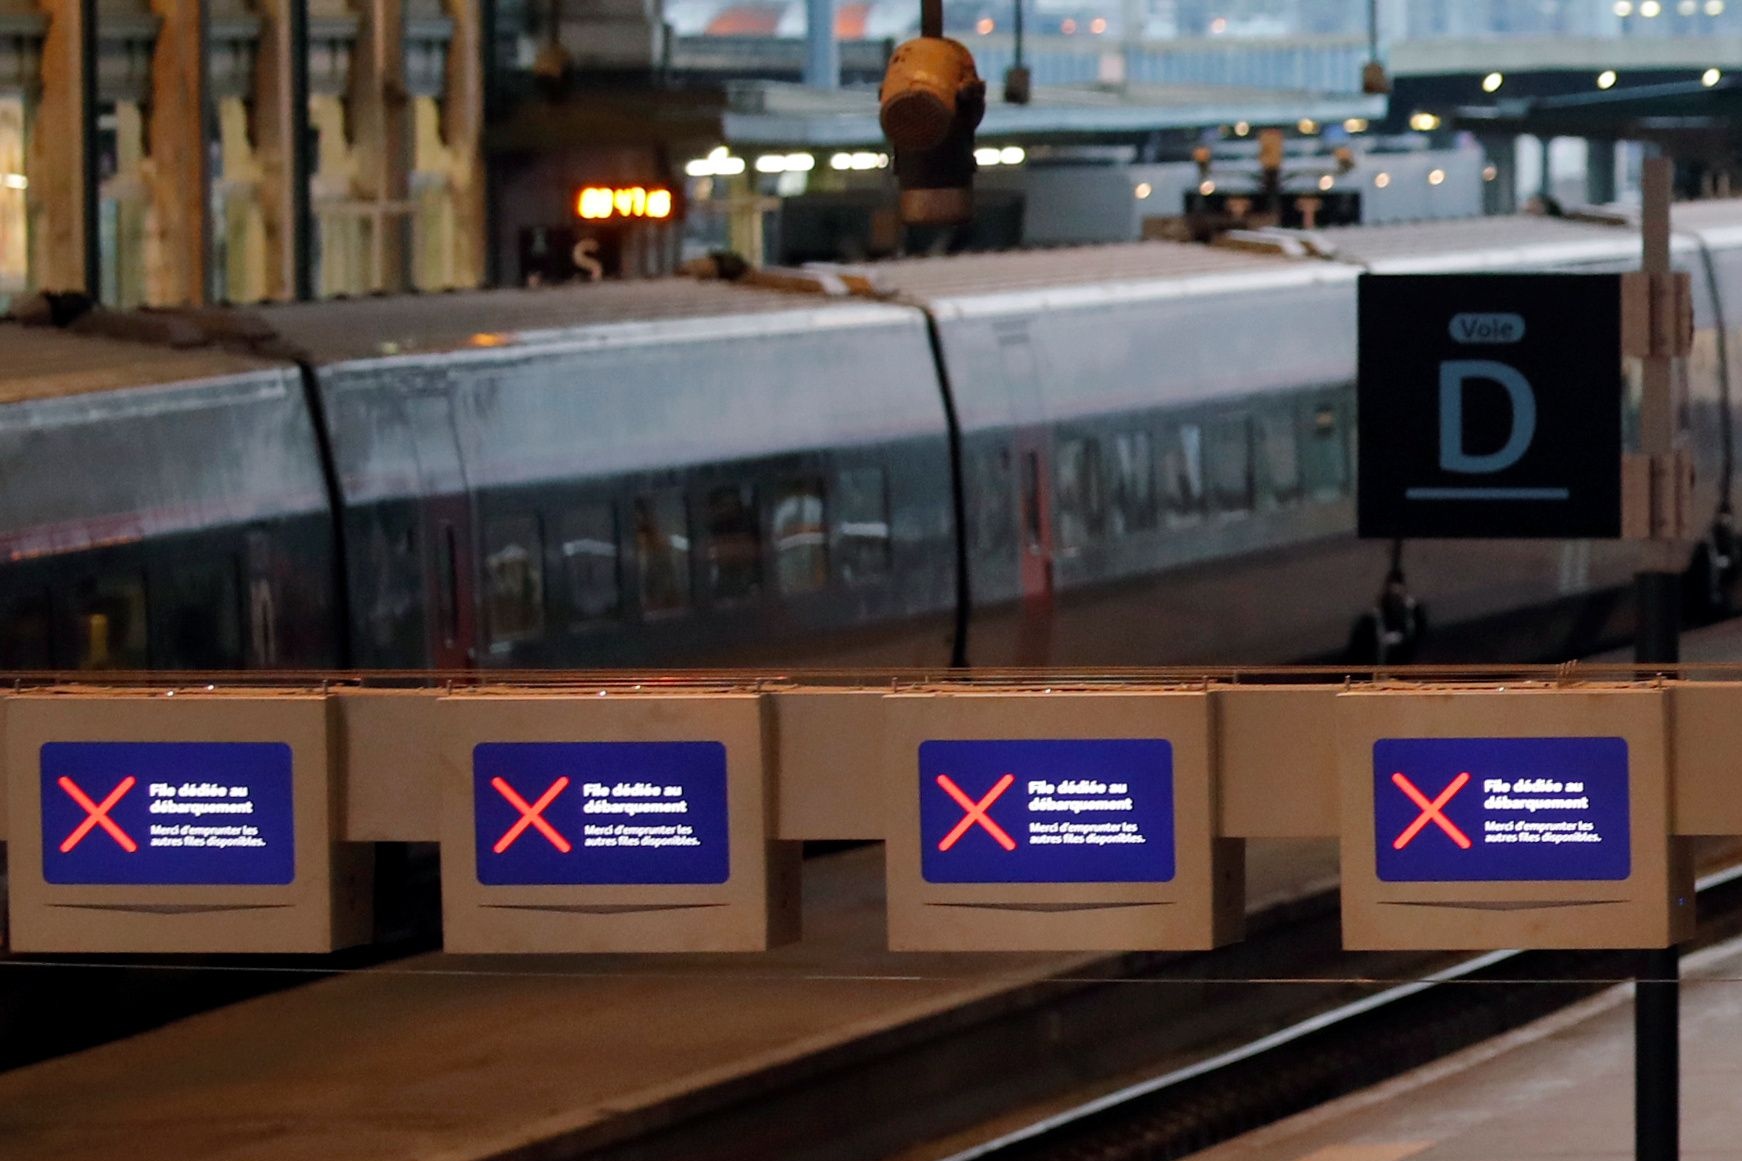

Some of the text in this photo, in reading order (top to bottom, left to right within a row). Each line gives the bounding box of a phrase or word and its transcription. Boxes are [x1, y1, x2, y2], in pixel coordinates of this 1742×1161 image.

[1459, 317, 1515, 339] Voie
[1440, 359, 1537, 473] D
[149, 783, 248, 797] File dédiée au
[583, 782, 682, 797] File dédiée au
[1028, 780, 1127, 794] File dédiée au
[1484, 778, 1583, 792] File dédiée au
[149, 799, 253, 816] débarquement
[583, 799, 687, 816] débarquement
[1028, 797, 1133, 814] débarquement
[1484, 795, 1589, 812] débarquement
[150, 825, 179, 835] Merci
[242, 825, 258, 835] les
[584, 824, 613, 835] Merci
[677, 824, 692, 835] les
[1029, 822, 1058, 832] Merci
[1122, 822, 1138, 832] les
[1485, 821, 1514, 831] Merci
[1578, 821, 1594, 831] les
[150, 837, 182, 846] autres
[584, 837, 617, 846] autres
[1029, 835, 1062, 844] autres
[1485, 833, 1518, 842] autres
